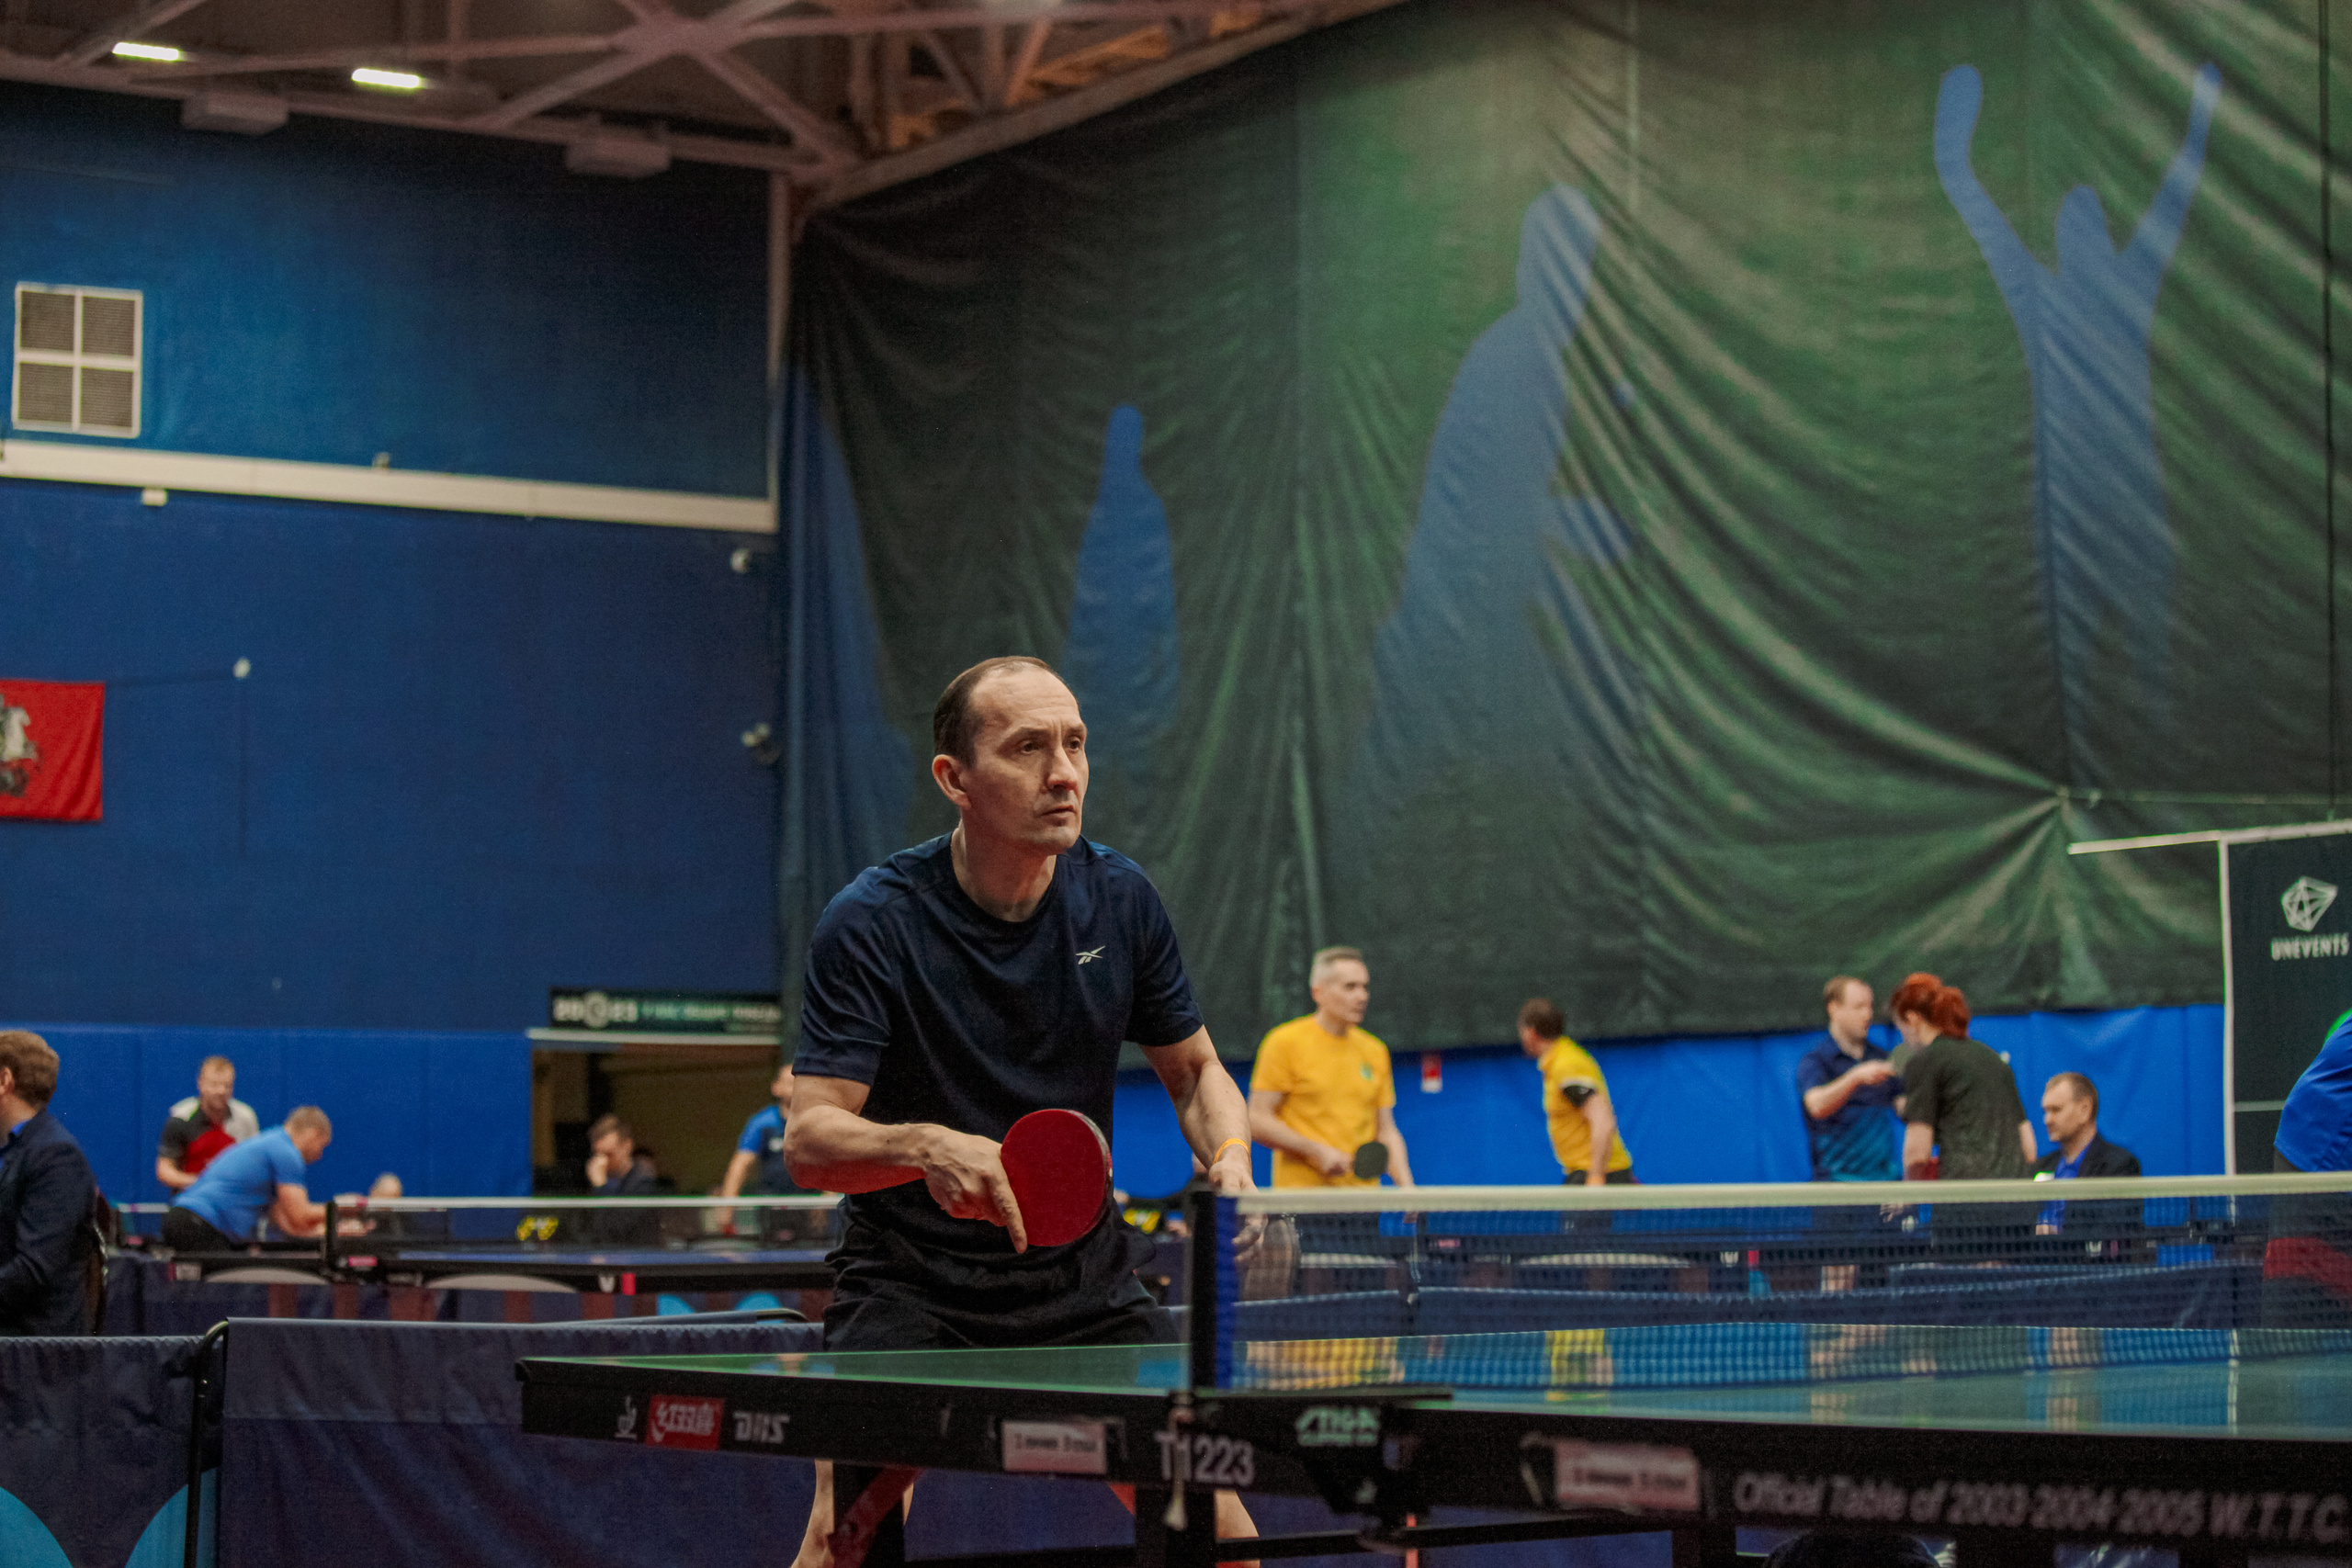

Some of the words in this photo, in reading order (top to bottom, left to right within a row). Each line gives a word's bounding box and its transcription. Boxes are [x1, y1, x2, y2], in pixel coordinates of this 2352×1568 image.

[2270, 932, 2350, 961] UNEVENTS
[1734, 1471, 1825, 1515] Official
[1830, 1473, 1907, 1521] Table
[1909, 1478, 1949, 1523] of
